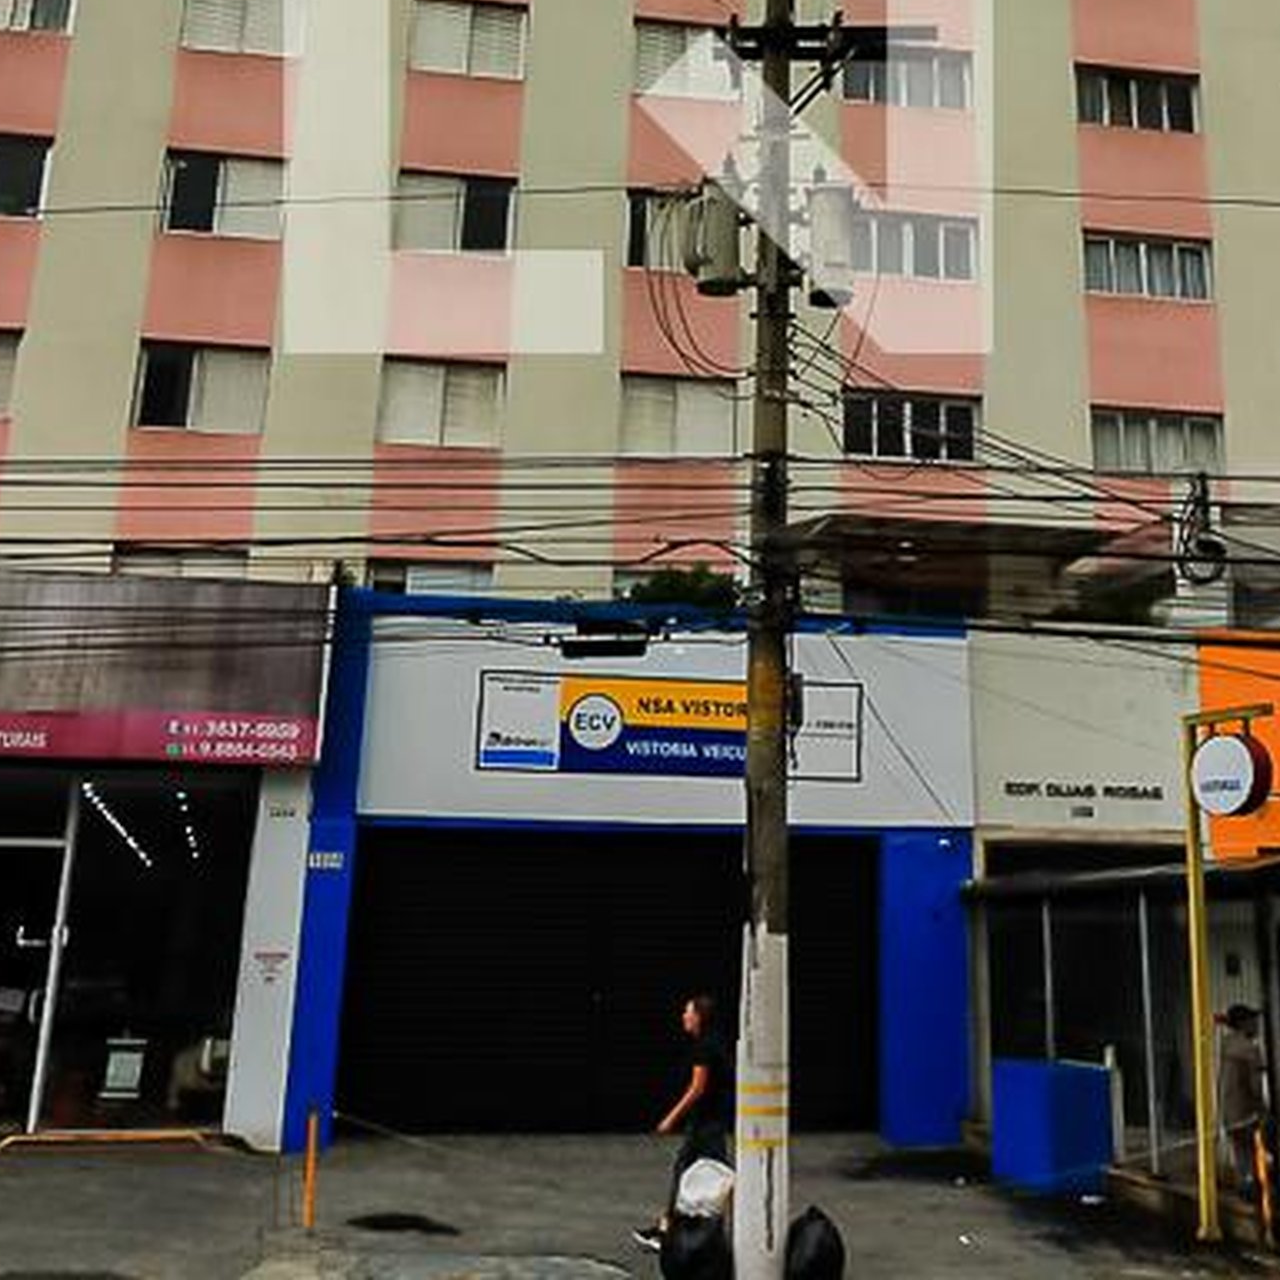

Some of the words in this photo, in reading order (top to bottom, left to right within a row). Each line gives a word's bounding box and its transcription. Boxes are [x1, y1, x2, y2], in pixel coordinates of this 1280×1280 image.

[636, 697, 674, 714] NSA
[681, 699, 747, 717] VISTOR
[574, 712, 617, 731] ECV
[625, 739, 699, 758] VISTORIA
[702, 743, 747, 761] VEICU
